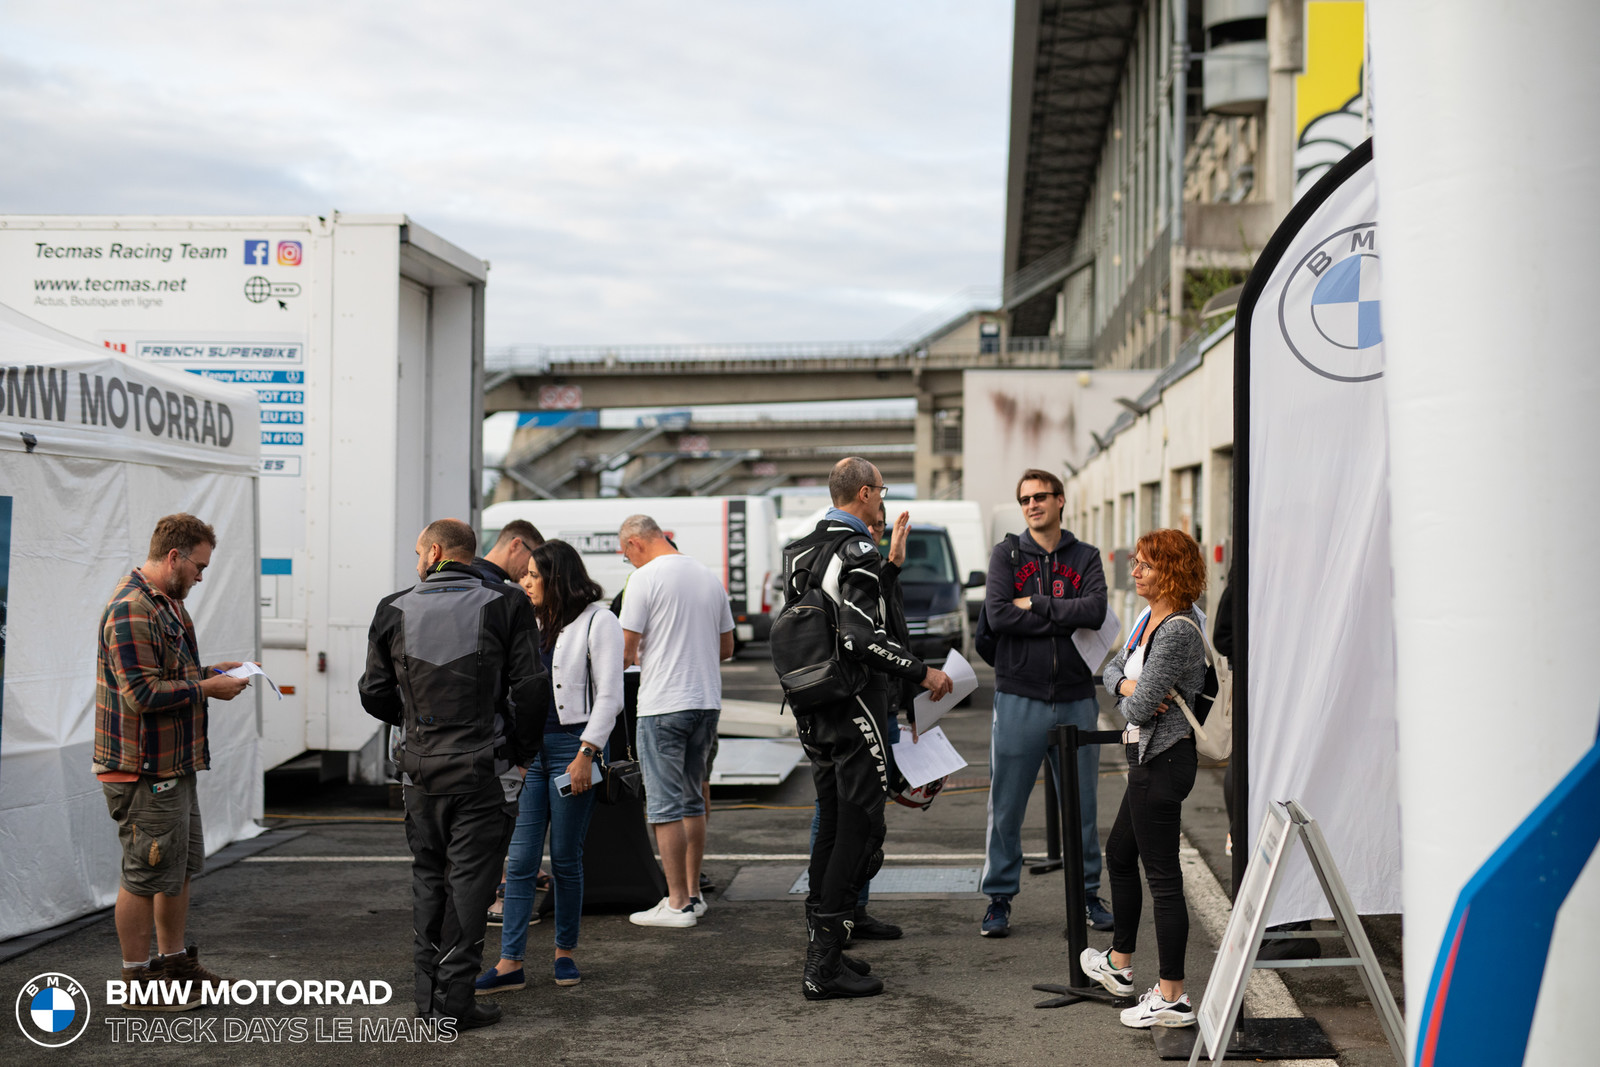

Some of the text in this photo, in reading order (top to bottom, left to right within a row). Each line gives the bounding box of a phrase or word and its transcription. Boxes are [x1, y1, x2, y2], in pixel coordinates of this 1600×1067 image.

[35, 242, 228, 262] Tecmas Racing Team
[1306, 227, 1375, 278] BM
[34, 277, 187, 292] www.tecmas.net
[70, 295, 118, 307] Boutique
[137, 295, 163, 309] ligne
[141, 345, 298, 359] FRENCH SUPERBIKE
[235, 371, 274, 382] FORAY
[79, 372, 234, 448] MOTORRAD
[1052, 580, 1064, 597] 8
